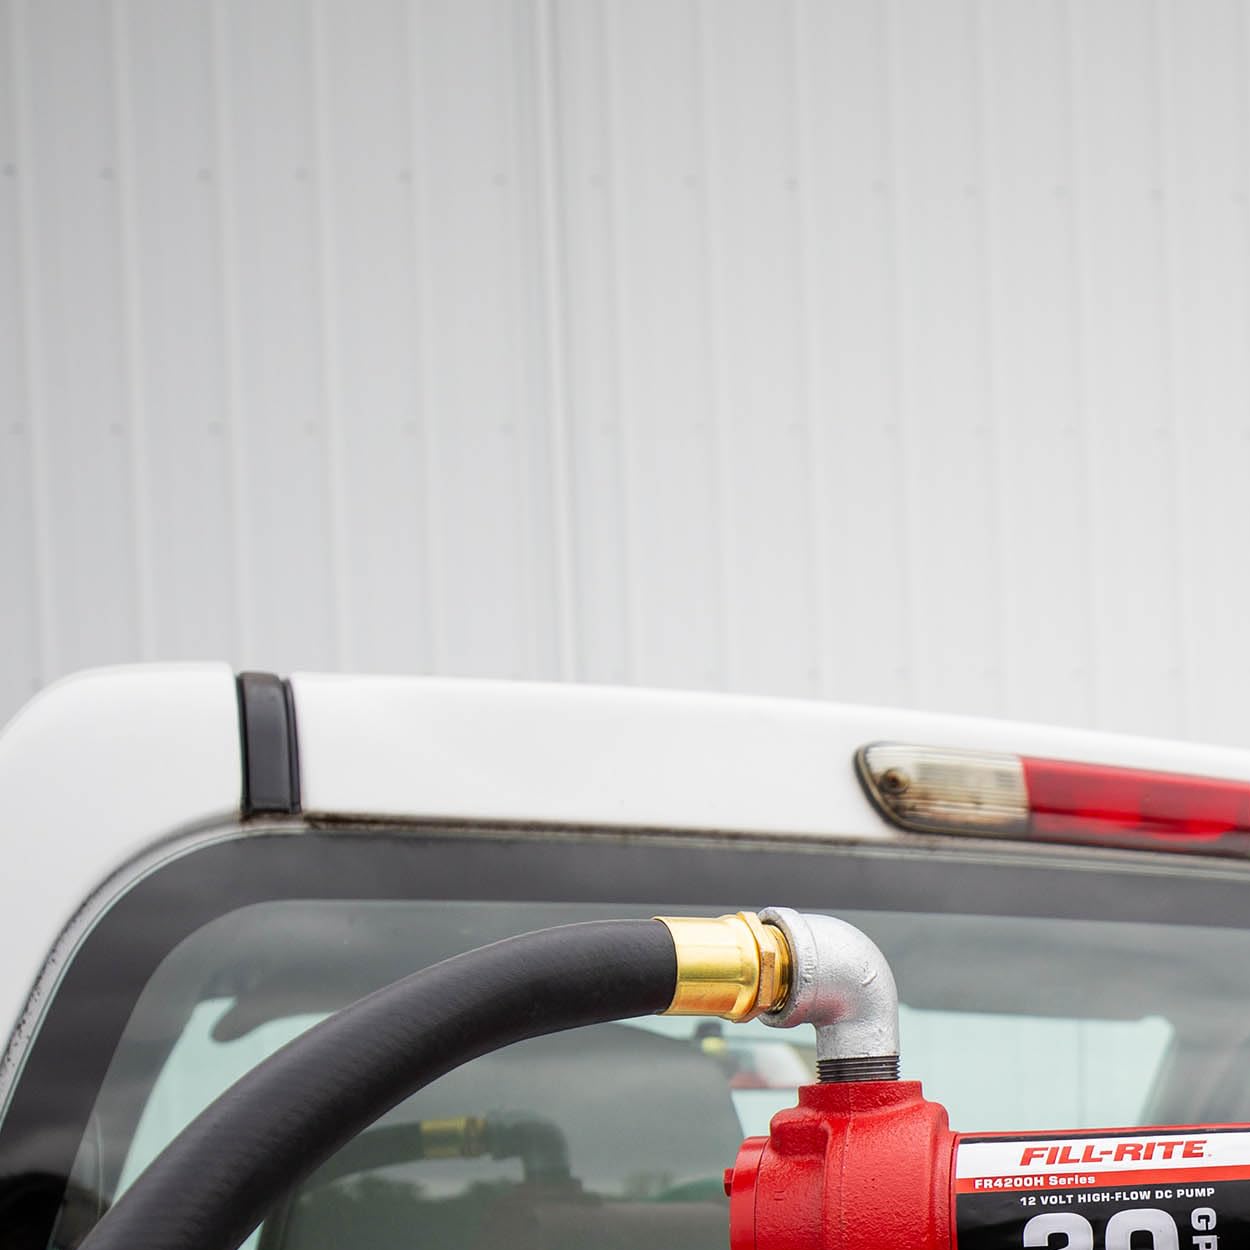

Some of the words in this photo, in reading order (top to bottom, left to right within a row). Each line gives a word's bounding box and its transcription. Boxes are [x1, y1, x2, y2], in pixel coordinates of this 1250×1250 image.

[1019, 1140, 1207, 1166] FILL-RITE
[974, 1177, 1044, 1189] FR4200H
[1048, 1175, 1096, 1186] Series
[1020, 1197, 1037, 1207] 12
[1039, 1195, 1073, 1205] VOLT
[1077, 1191, 1151, 1203] HIGH-FLOW
[1155, 1190, 1173, 1199] DC
[1176, 1188, 1215, 1199] PUMP
